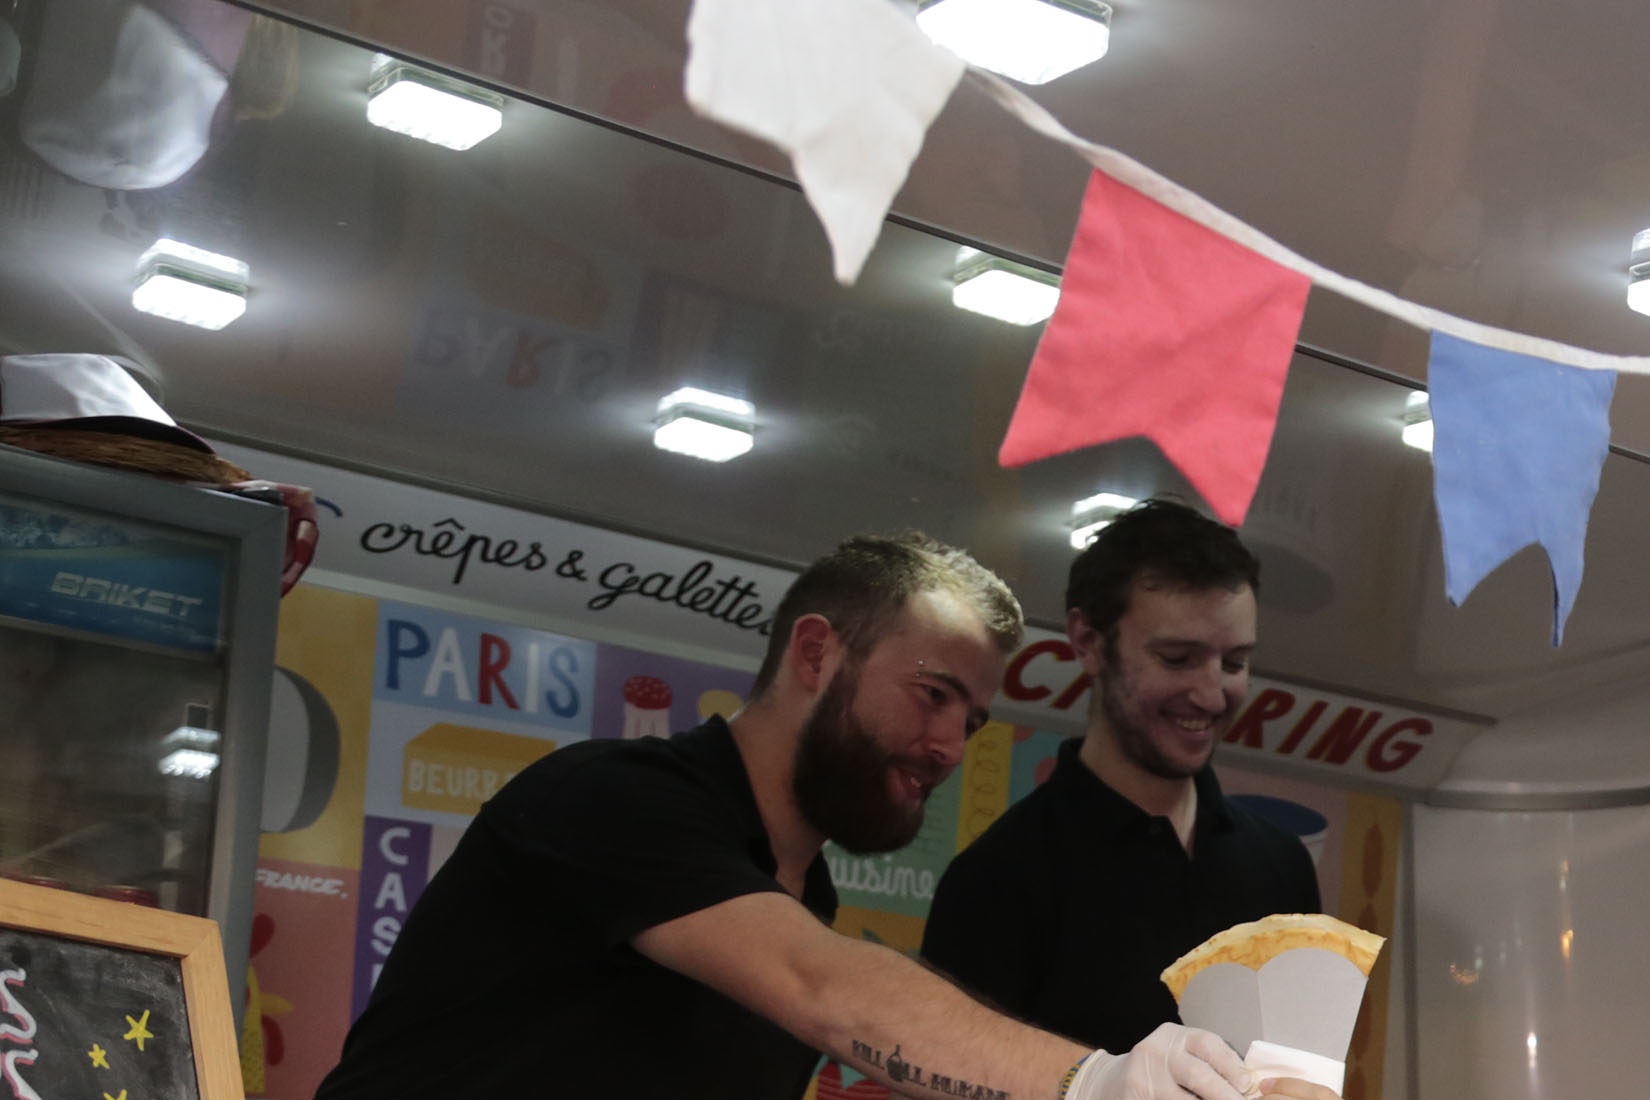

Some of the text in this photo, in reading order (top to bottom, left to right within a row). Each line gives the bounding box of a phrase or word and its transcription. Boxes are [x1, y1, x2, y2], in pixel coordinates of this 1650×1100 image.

[359, 517, 547, 585] crêpes
[555, 549, 588, 582] &
[51, 571, 204, 618] BRIKET
[385, 618, 581, 719] PARIS
[406, 759, 517, 799] BEURR
[821, 838, 935, 900] uisine
